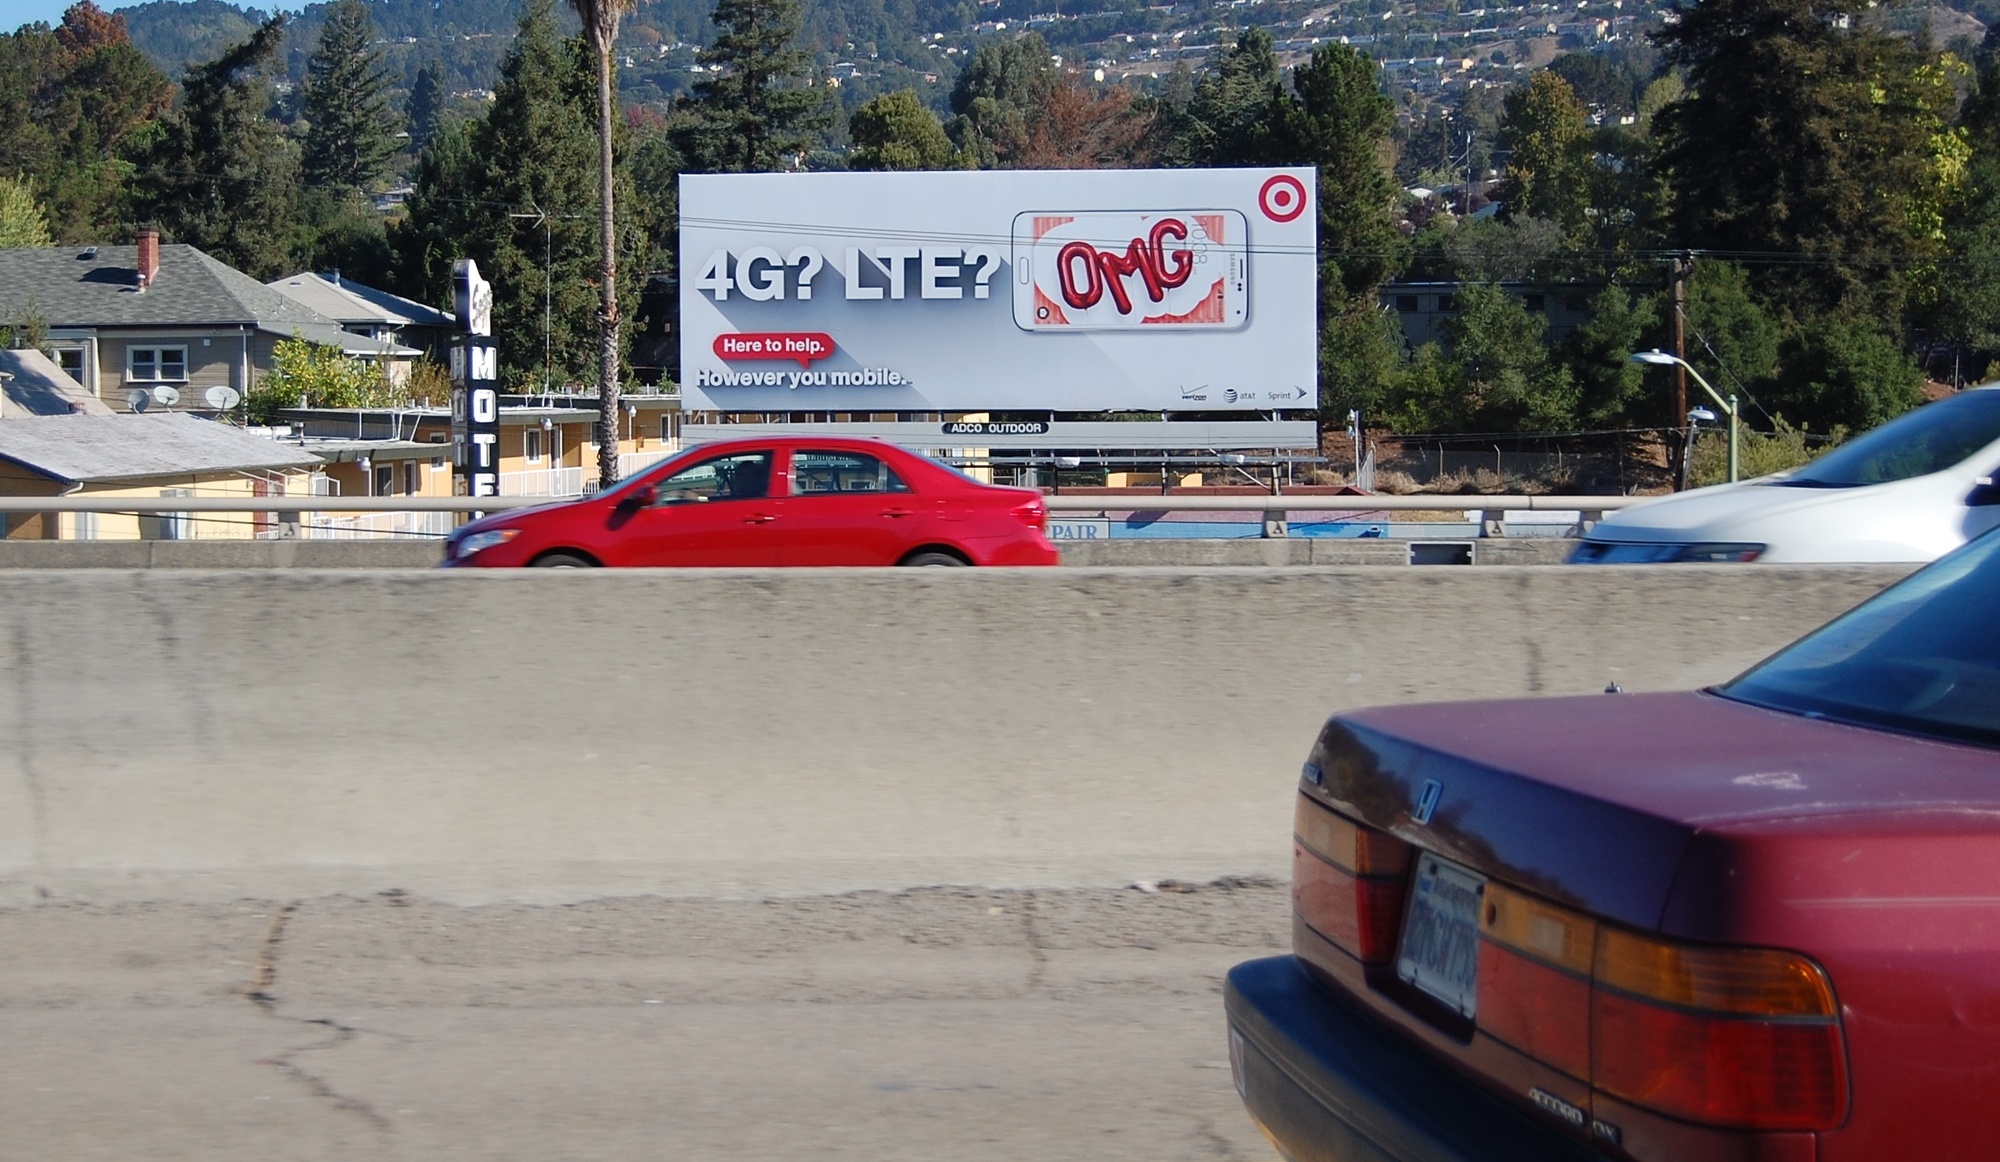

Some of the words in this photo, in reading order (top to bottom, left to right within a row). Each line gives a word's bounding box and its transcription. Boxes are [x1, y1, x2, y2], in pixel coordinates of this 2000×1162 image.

[694, 246, 824, 302] 4G?
[845, 246, 1001, 300] LTE?
[1056, 217, 1193, 315] OMG
[723, 338, 763, 352] Here
[765, 339, 782, 352] to
[785, 337, 826, 355] help.
[695, 368, 786, 387] However
[788, 371, 827, 390] you
[831, 367, 907, 387] mobile.
[1267, 391, 1291, 401] Sprint
[451, 346, 468, 527] MOTE
[472, 346, 497, 520] MOTE
[951, 423, 983, 433] ADCO
[988, 423, 1042, 433] OUTDOOR
[1044, 524, 1098, 540] PAIR
